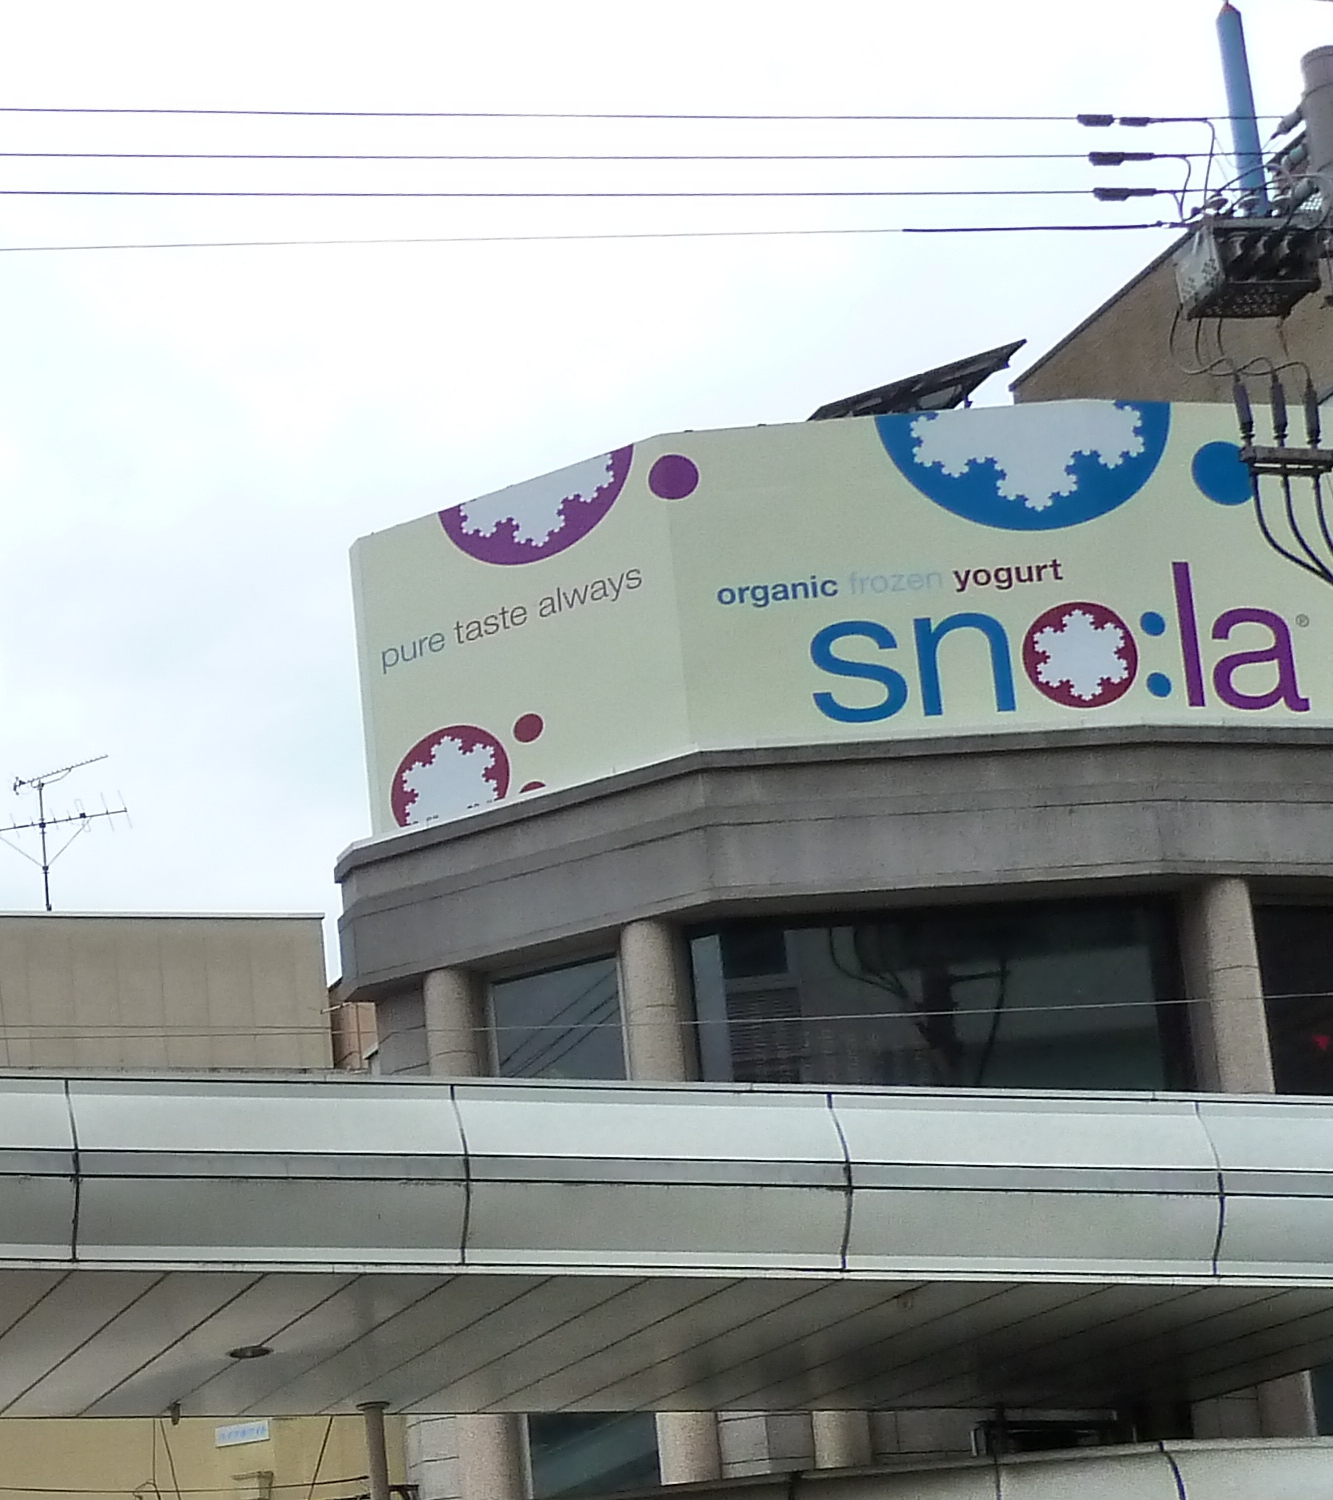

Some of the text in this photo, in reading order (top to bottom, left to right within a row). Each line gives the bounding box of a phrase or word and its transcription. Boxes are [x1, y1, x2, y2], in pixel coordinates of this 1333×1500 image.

[379, 566, 644, 674] pure taste always
[717, 557, 1064, 610] organic frozen yogurt
